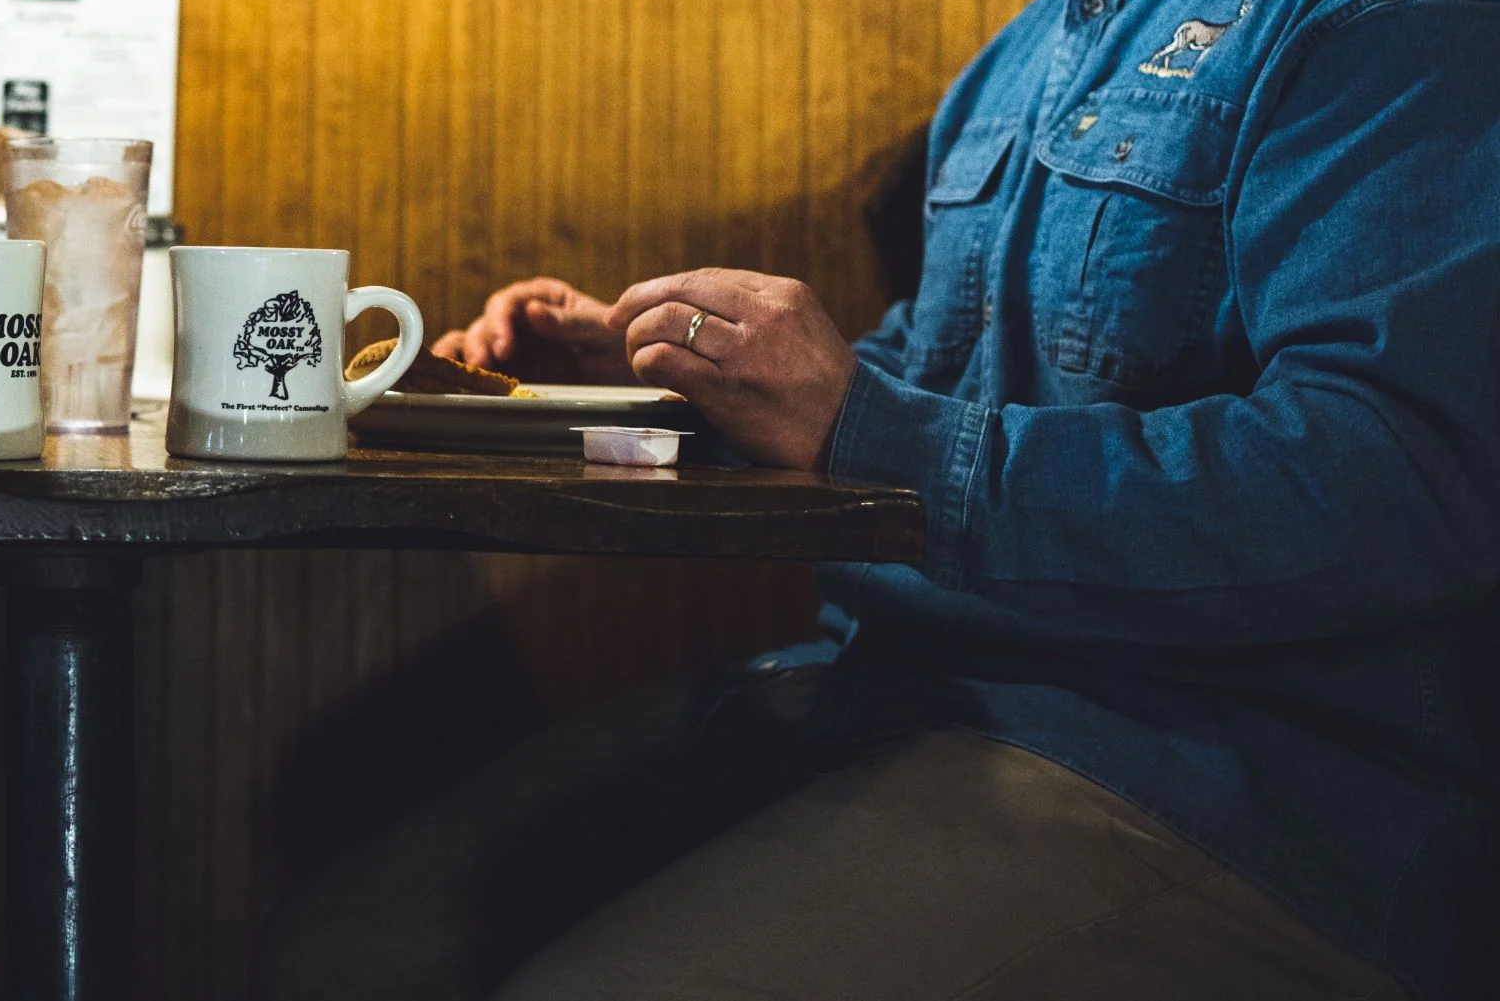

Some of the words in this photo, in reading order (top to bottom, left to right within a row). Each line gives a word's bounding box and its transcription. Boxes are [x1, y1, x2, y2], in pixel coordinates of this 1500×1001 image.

[257, 326, 305, 338] MOSSY
[266, 338, 296, 350] OAK
[0, 341, 41, 367] OAK
[10, 370, 26, 378] EST.
[220, 402, 235, 410] The
[236, 403, 256, 411] First
